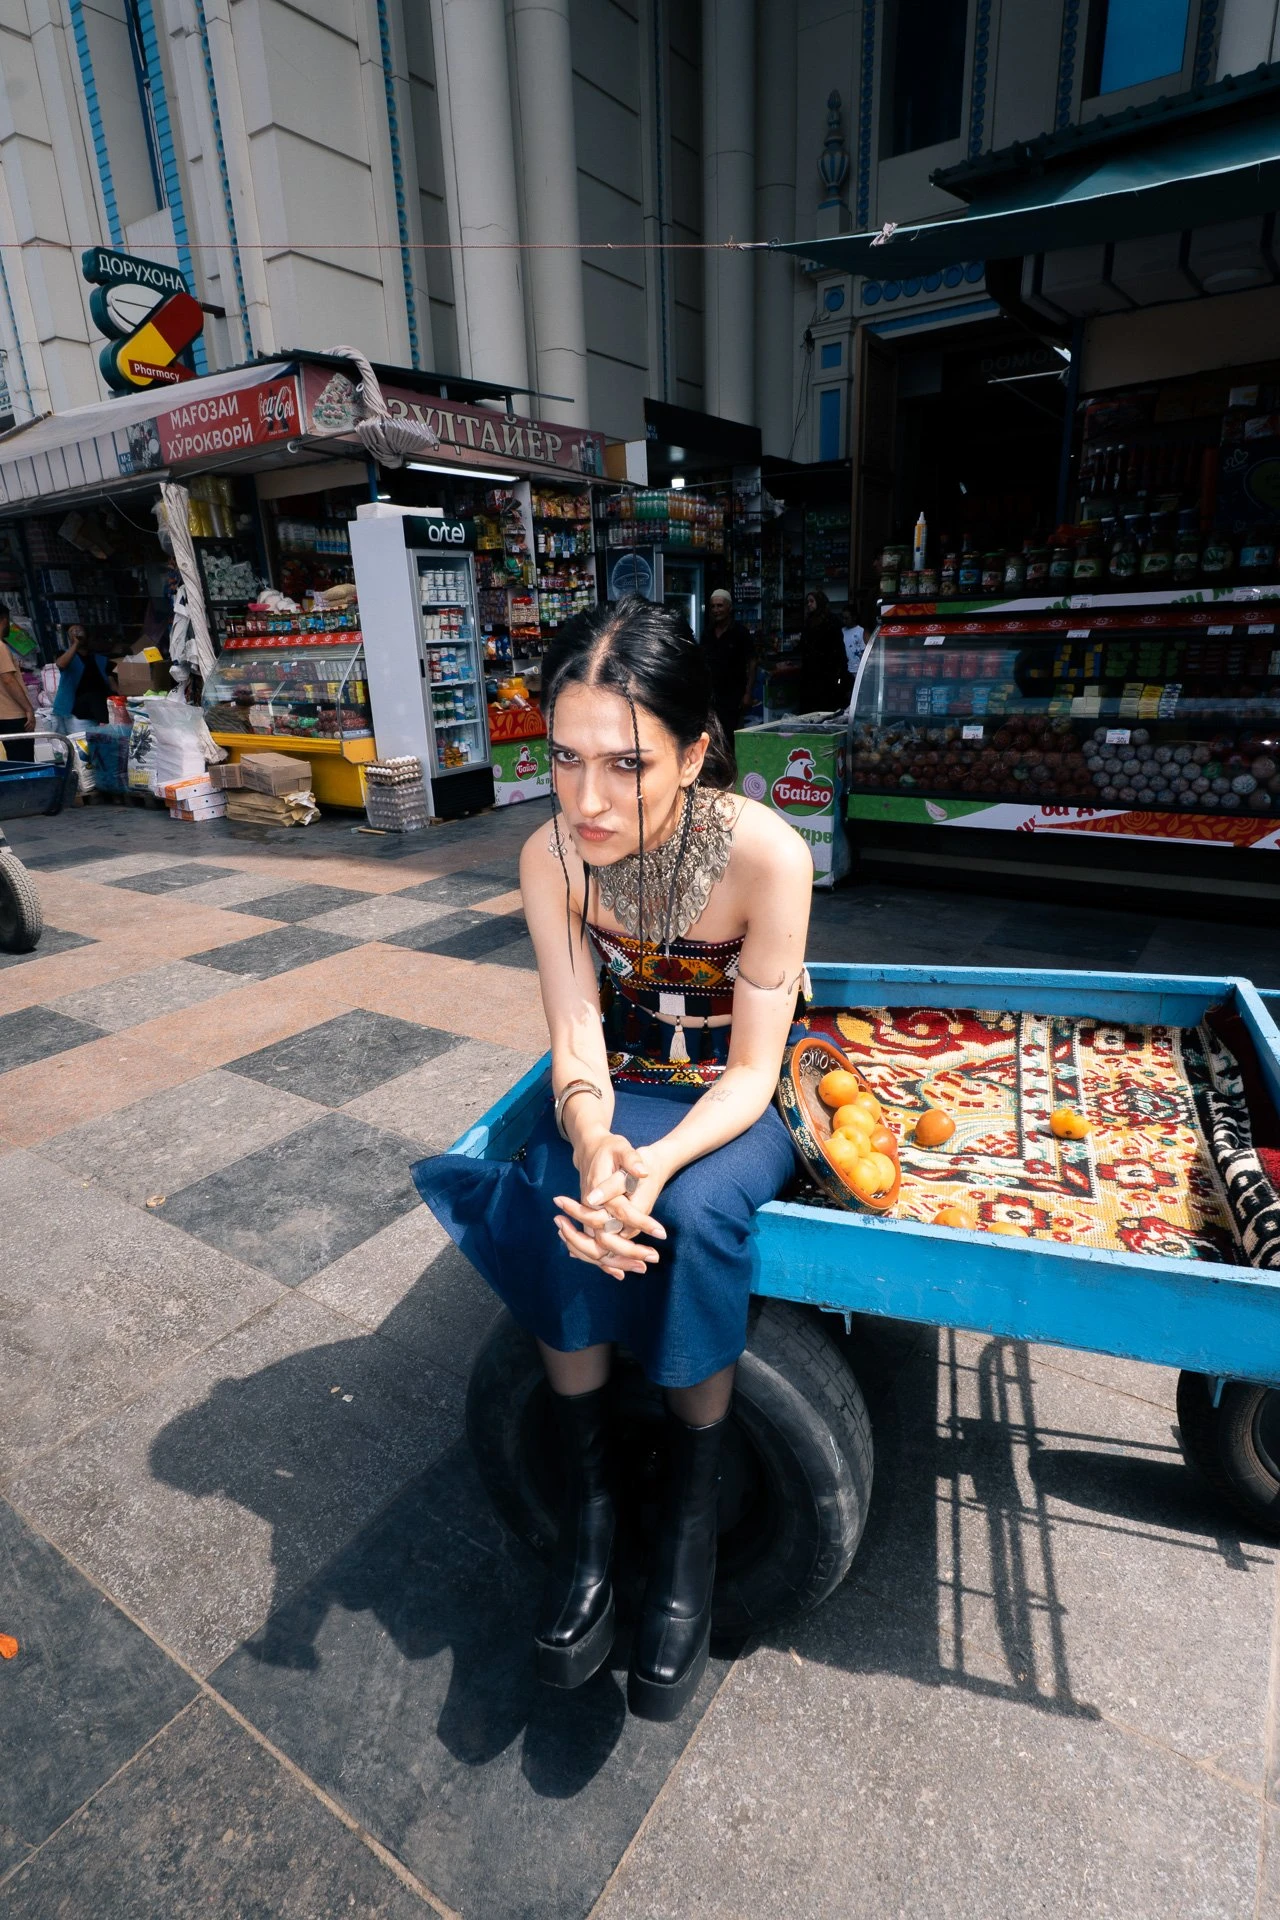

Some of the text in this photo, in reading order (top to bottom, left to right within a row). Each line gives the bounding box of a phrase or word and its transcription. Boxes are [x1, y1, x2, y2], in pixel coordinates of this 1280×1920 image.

[99, 254, 185, 292] ДОРУХОНА
[134, 363, 180, 382] Pharmacy
[170, 395, 239, 430] МАҒОЗАИ
[775, 783, 830, 803] Байзо
